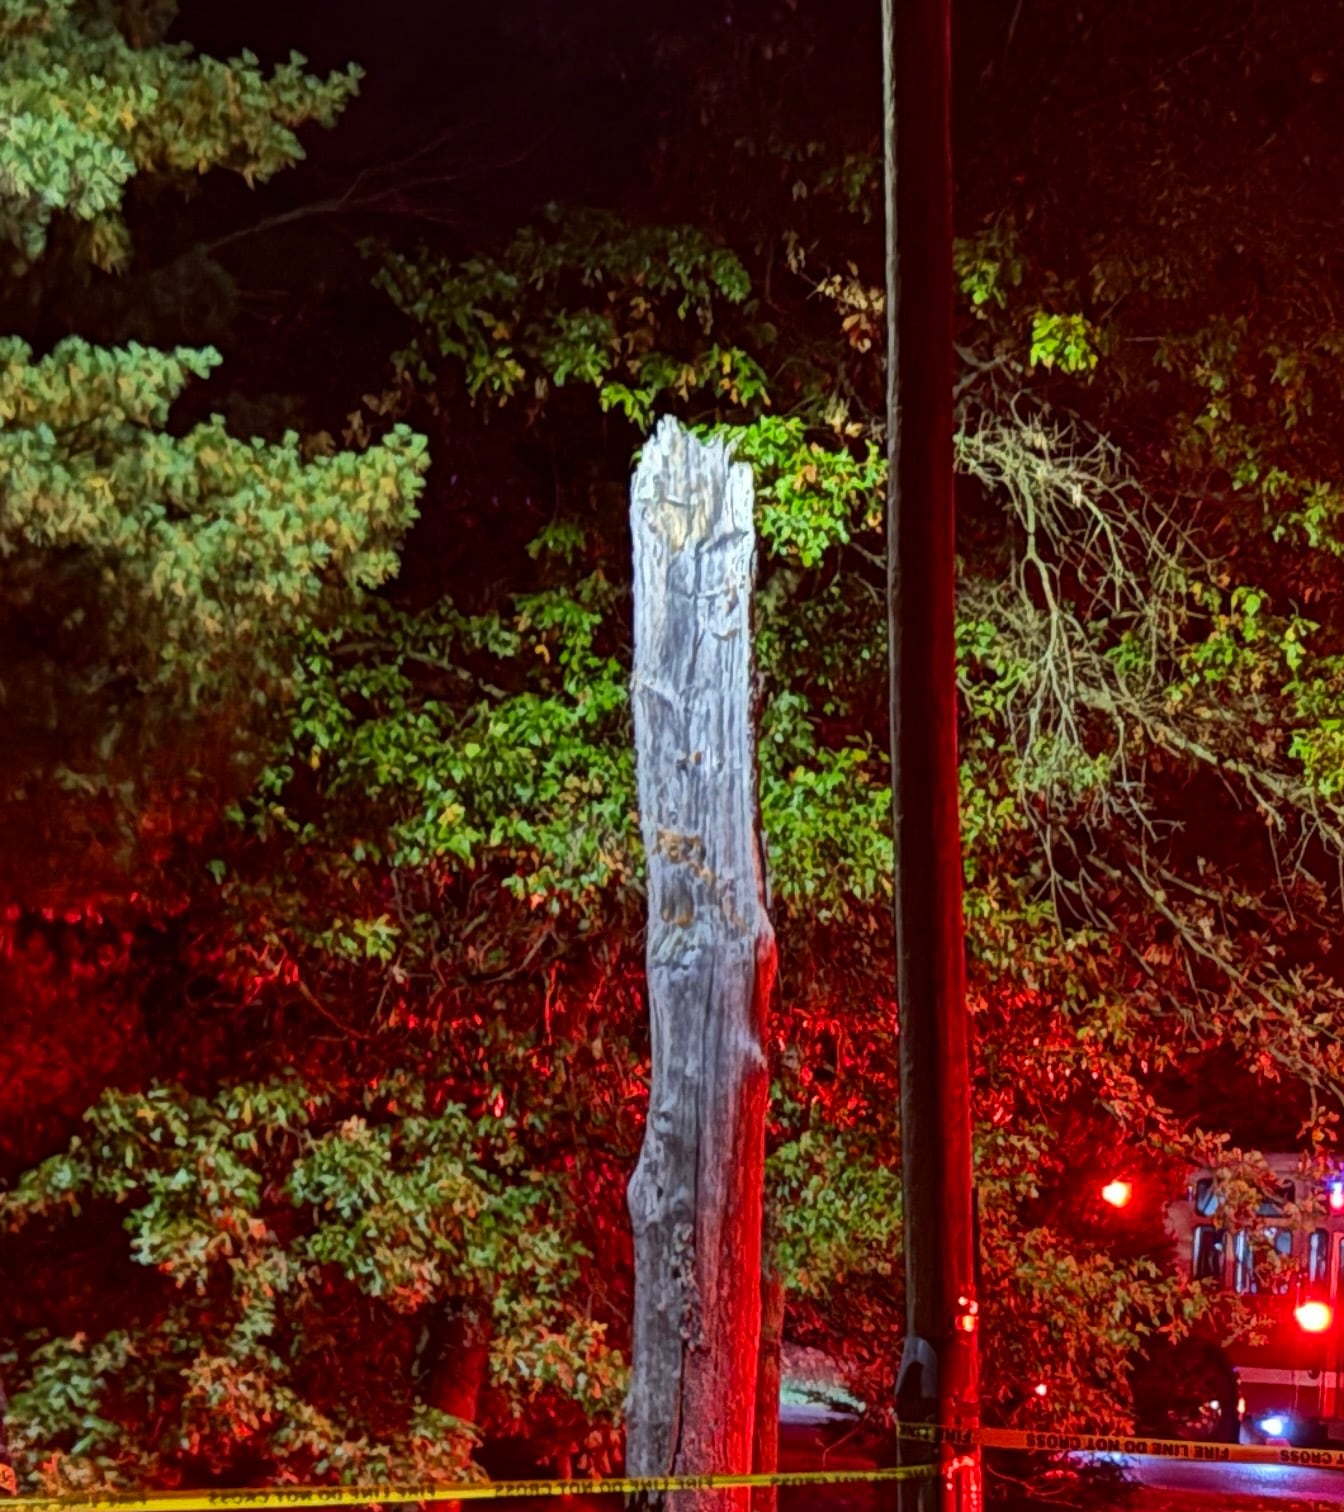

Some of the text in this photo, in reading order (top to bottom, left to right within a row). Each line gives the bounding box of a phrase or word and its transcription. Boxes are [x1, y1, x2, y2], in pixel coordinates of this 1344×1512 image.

[1026, 1432, 1230, 1460] FIRE LINE DO NOT CROSS
[1280, 1449, 1333, 1465] CROSS
